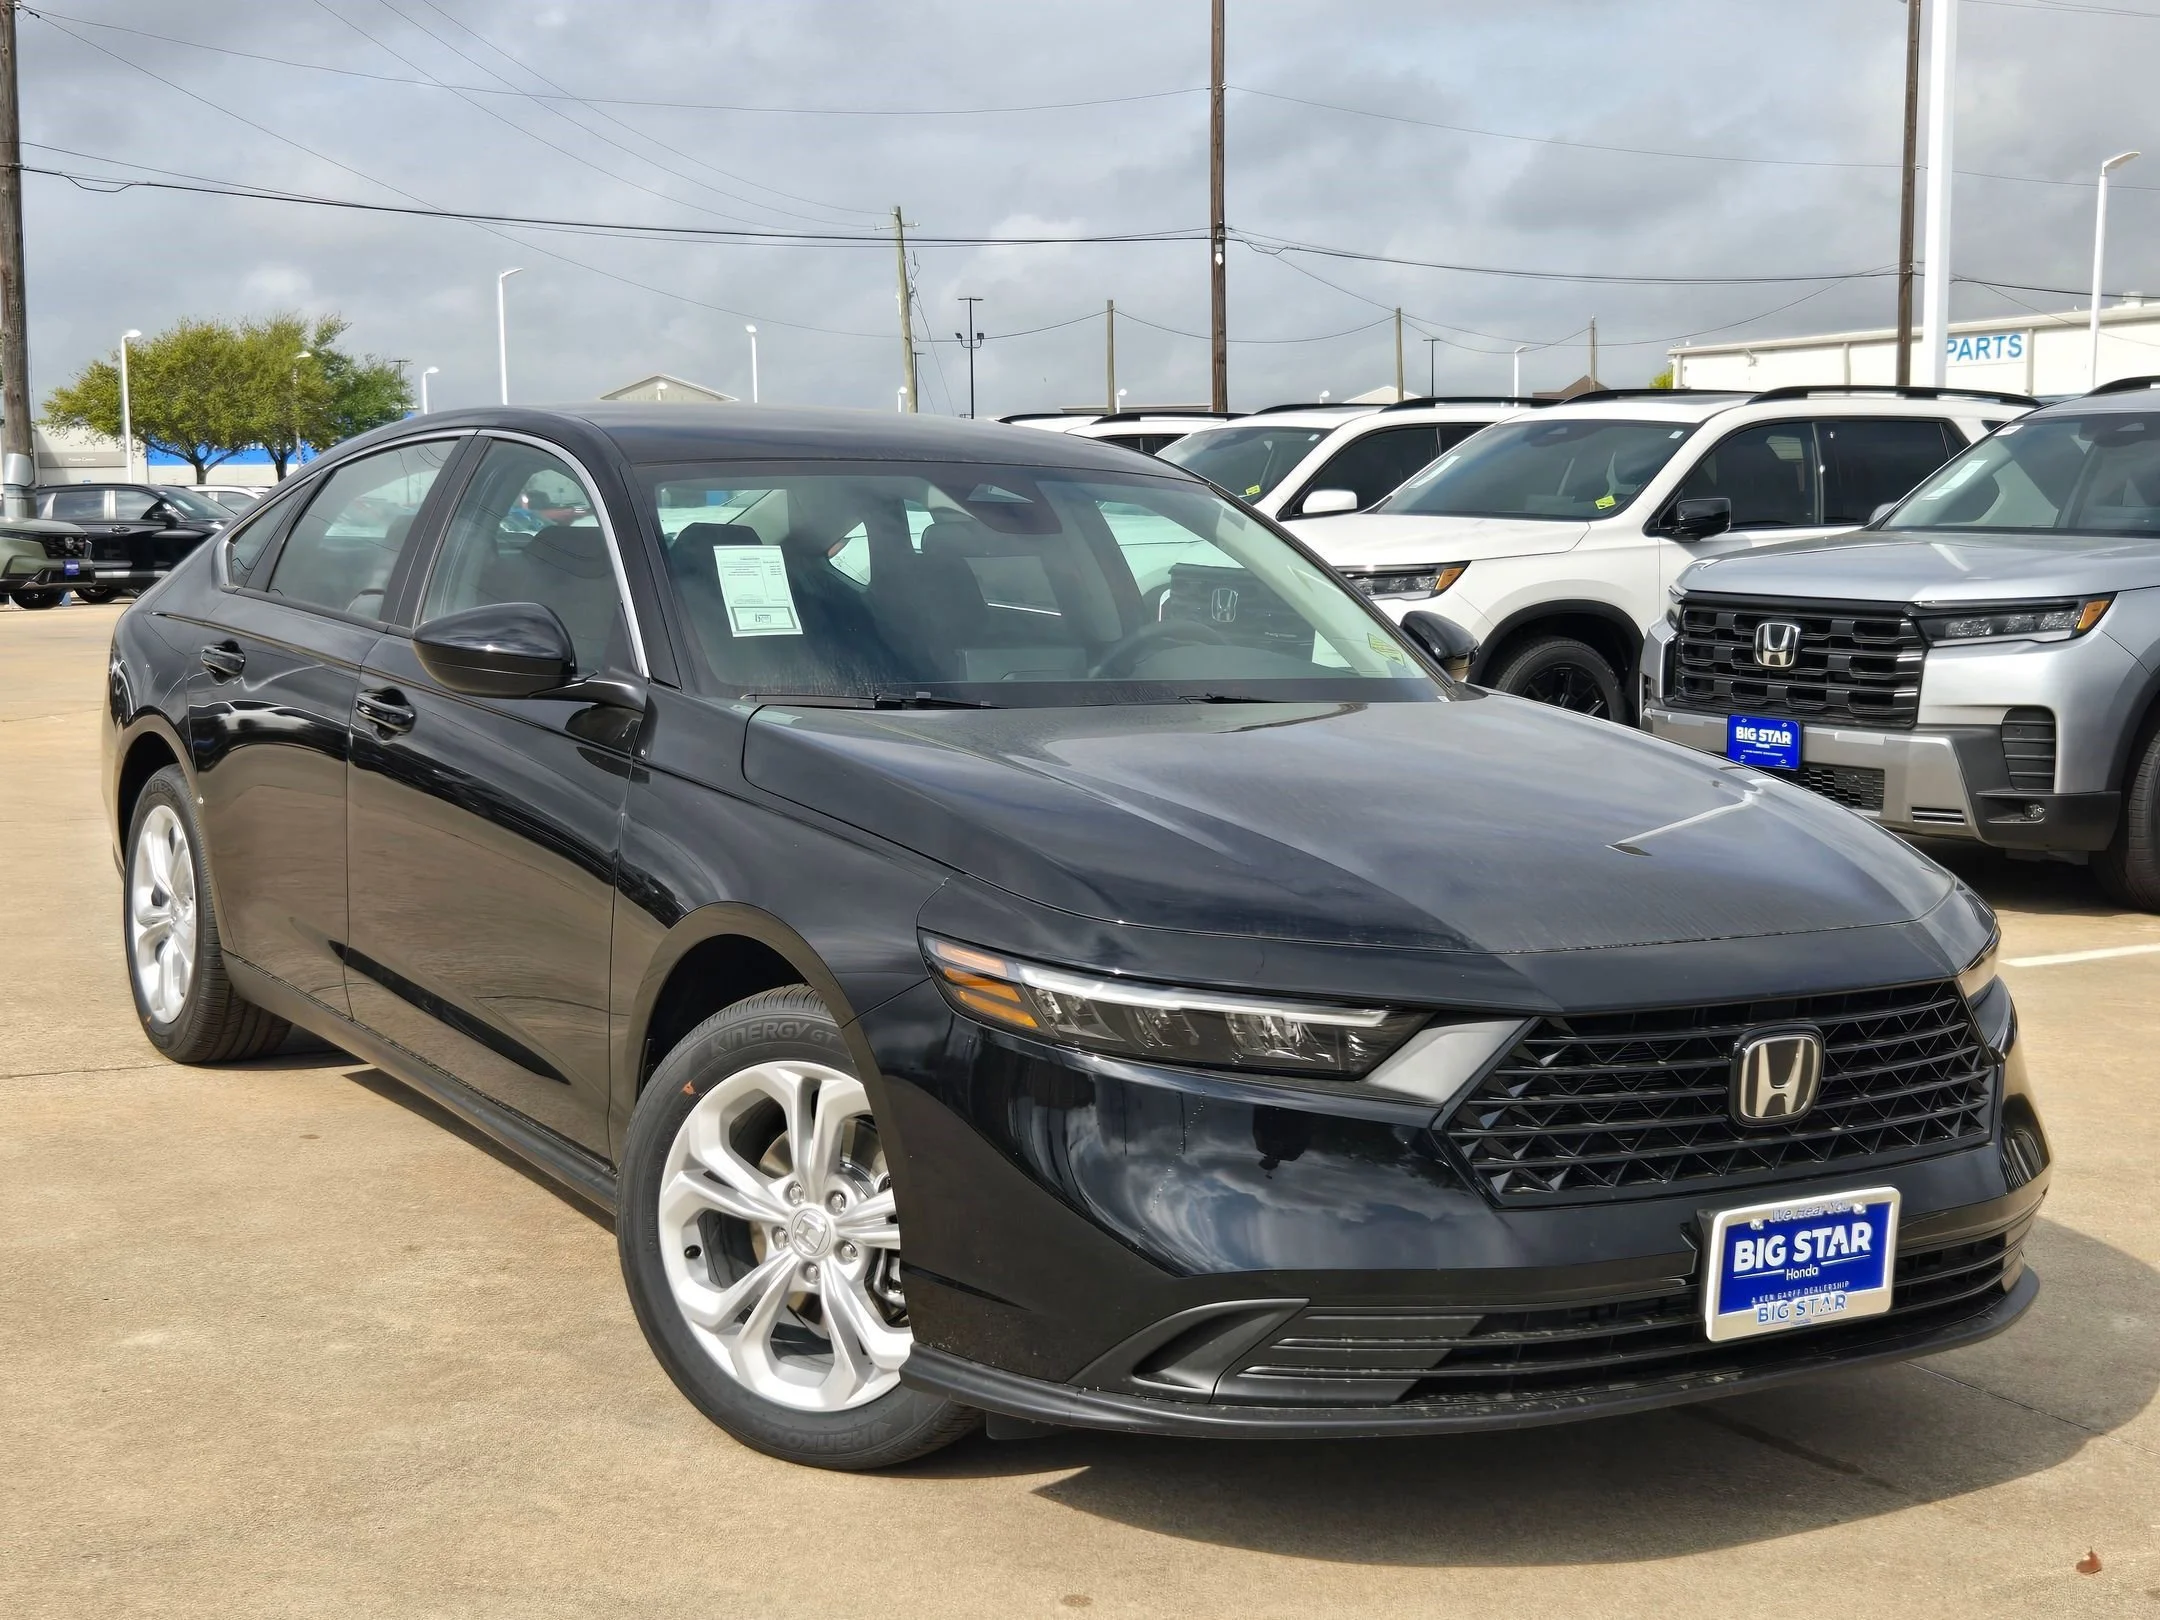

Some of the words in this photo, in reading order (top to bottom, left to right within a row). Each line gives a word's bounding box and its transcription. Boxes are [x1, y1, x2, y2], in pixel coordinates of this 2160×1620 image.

[1947, 334, 2022, 361] PARTS
[1736, 726, 1757, 741] BIG
[1759, 729, 1792, 745] STAR
[1733, 1235, 1786, 1272] BIG
[1793, 1222, 1872, 1262] STAR
[1786, 1264, 1819, 1281] Honda
[1759, 1294, 1774, 1303] KEN
[1777, 1288, 1801, 1300] GARFF
[1804, 1280, 1850, 1295] DEALERSHIP
[1757, 1303, 1790, 1323] BIG
[1796, 1293, 1847, 1316] STAR
